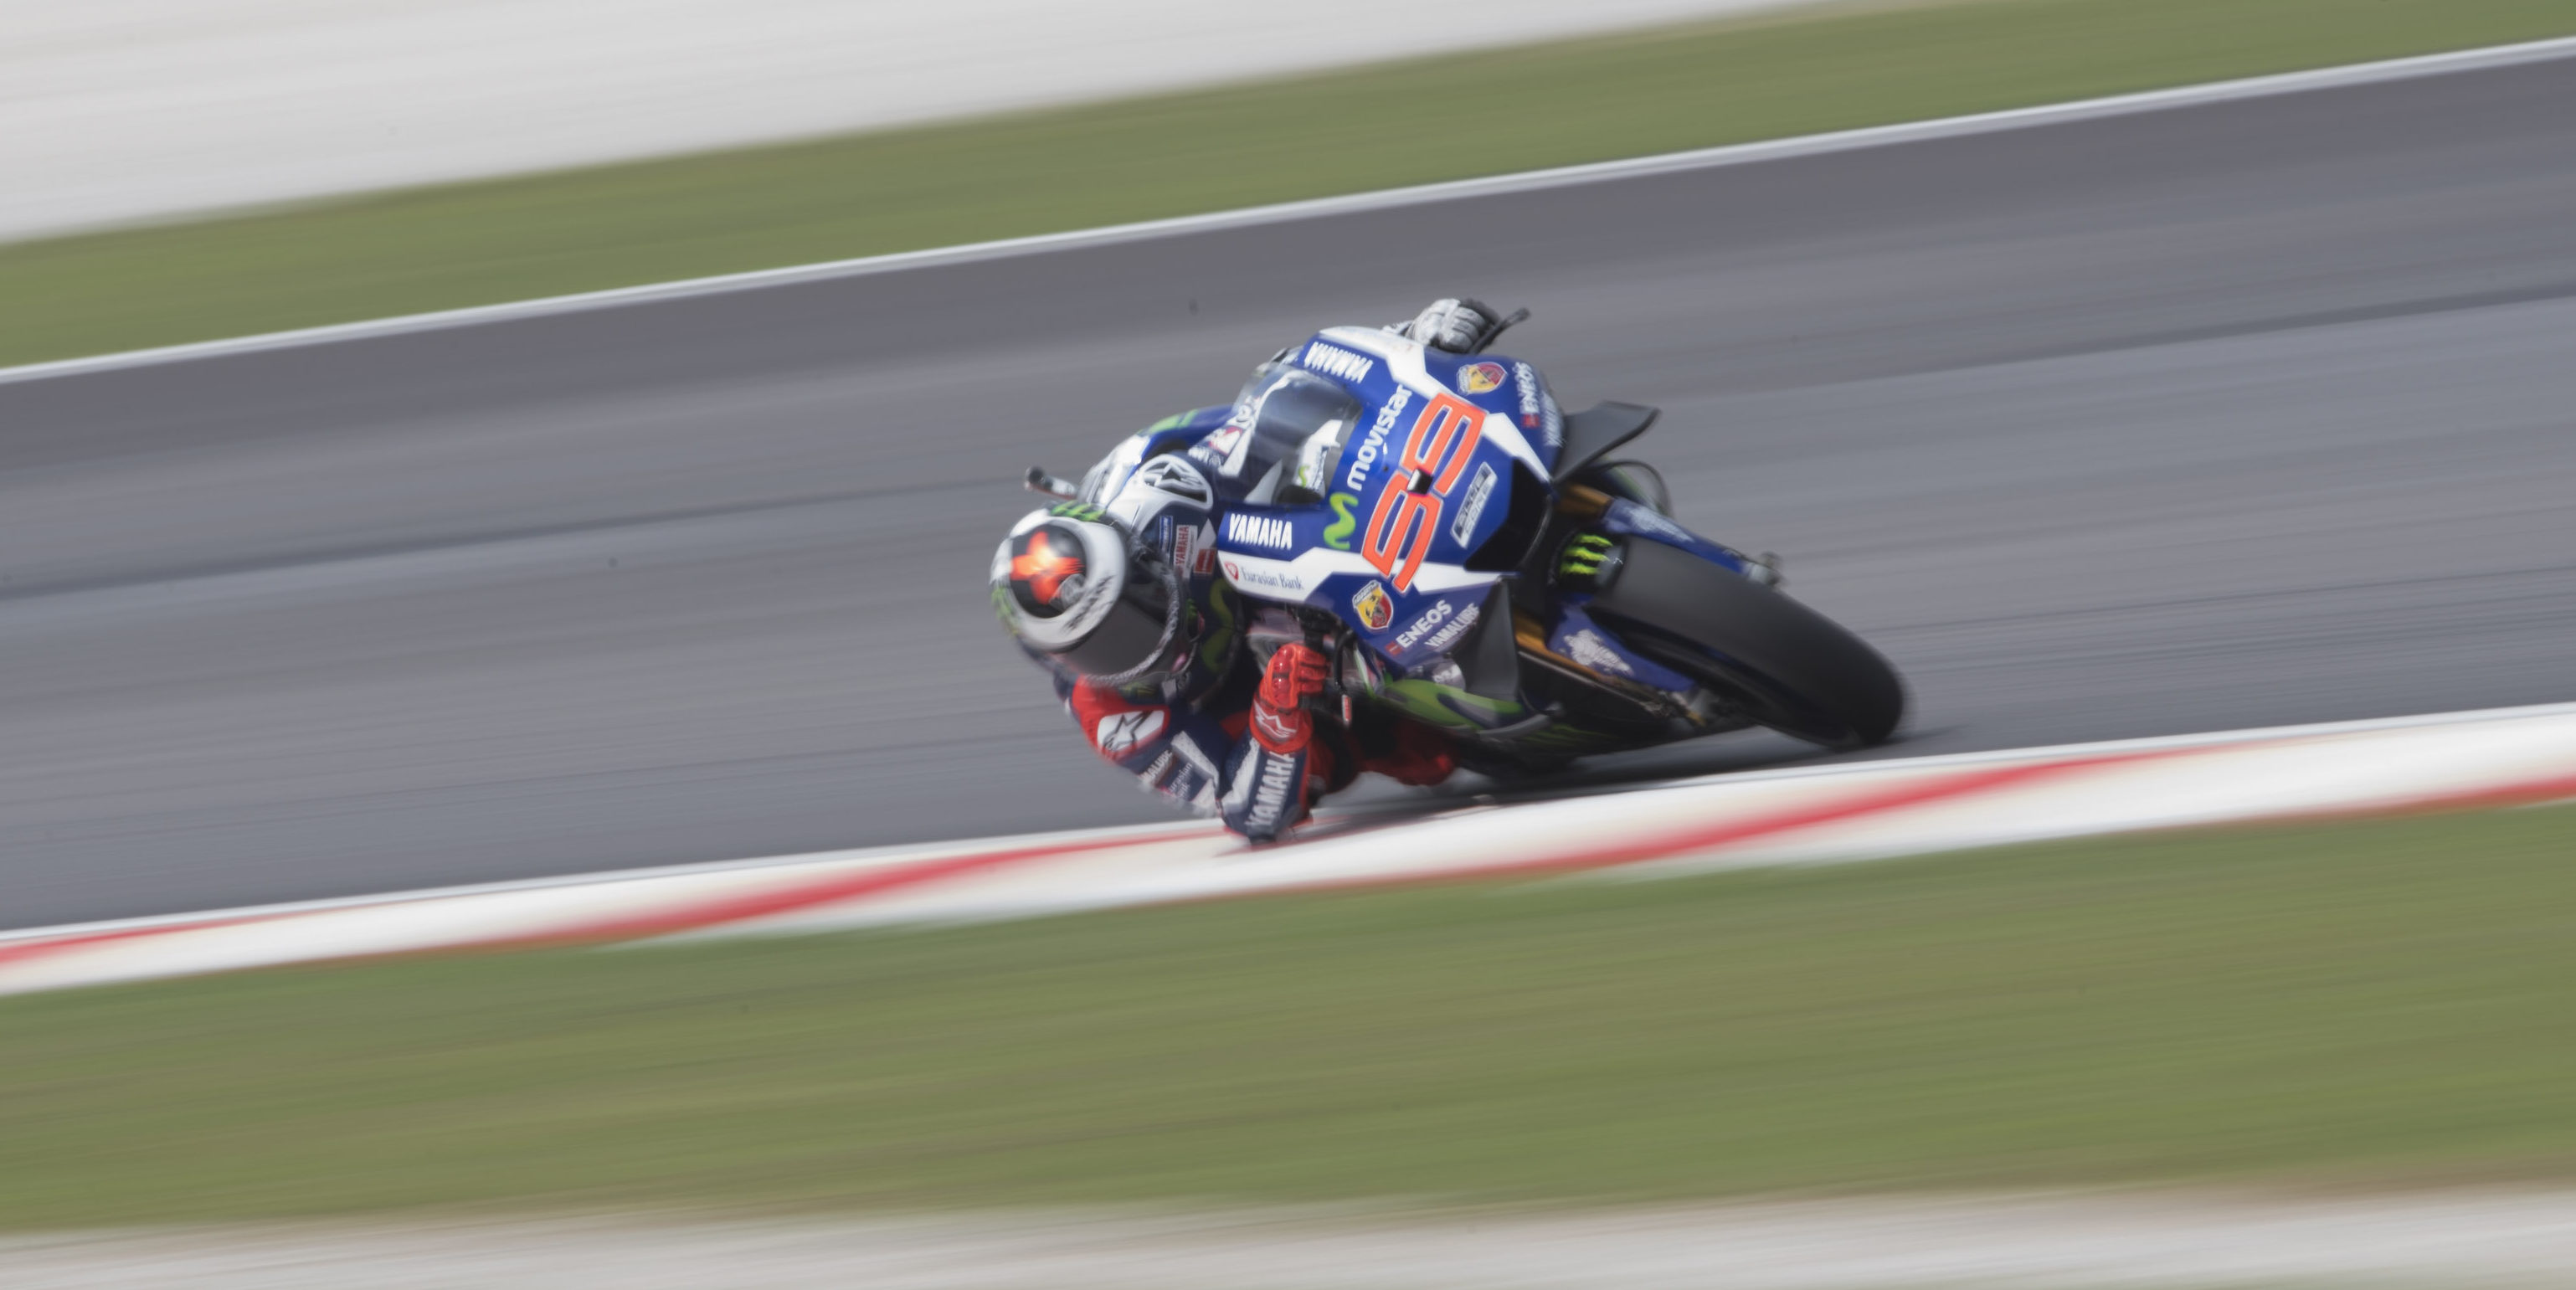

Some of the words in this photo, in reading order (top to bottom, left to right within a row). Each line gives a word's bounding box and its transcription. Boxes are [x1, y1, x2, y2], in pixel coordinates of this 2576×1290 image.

[1346, 383, 1412, 491] movistar
[1175, 526, 1190, 565] YAMAHA
[1228, 512, 1293, 551] YAMAHA
[1241, 567, 1279, 588] Eurasian
[1279, 573, 1304, 590] Bank
[1396, 599, 1452, 648] ENEOS
[1424, 603, 1480, 647] YAMALUBE
